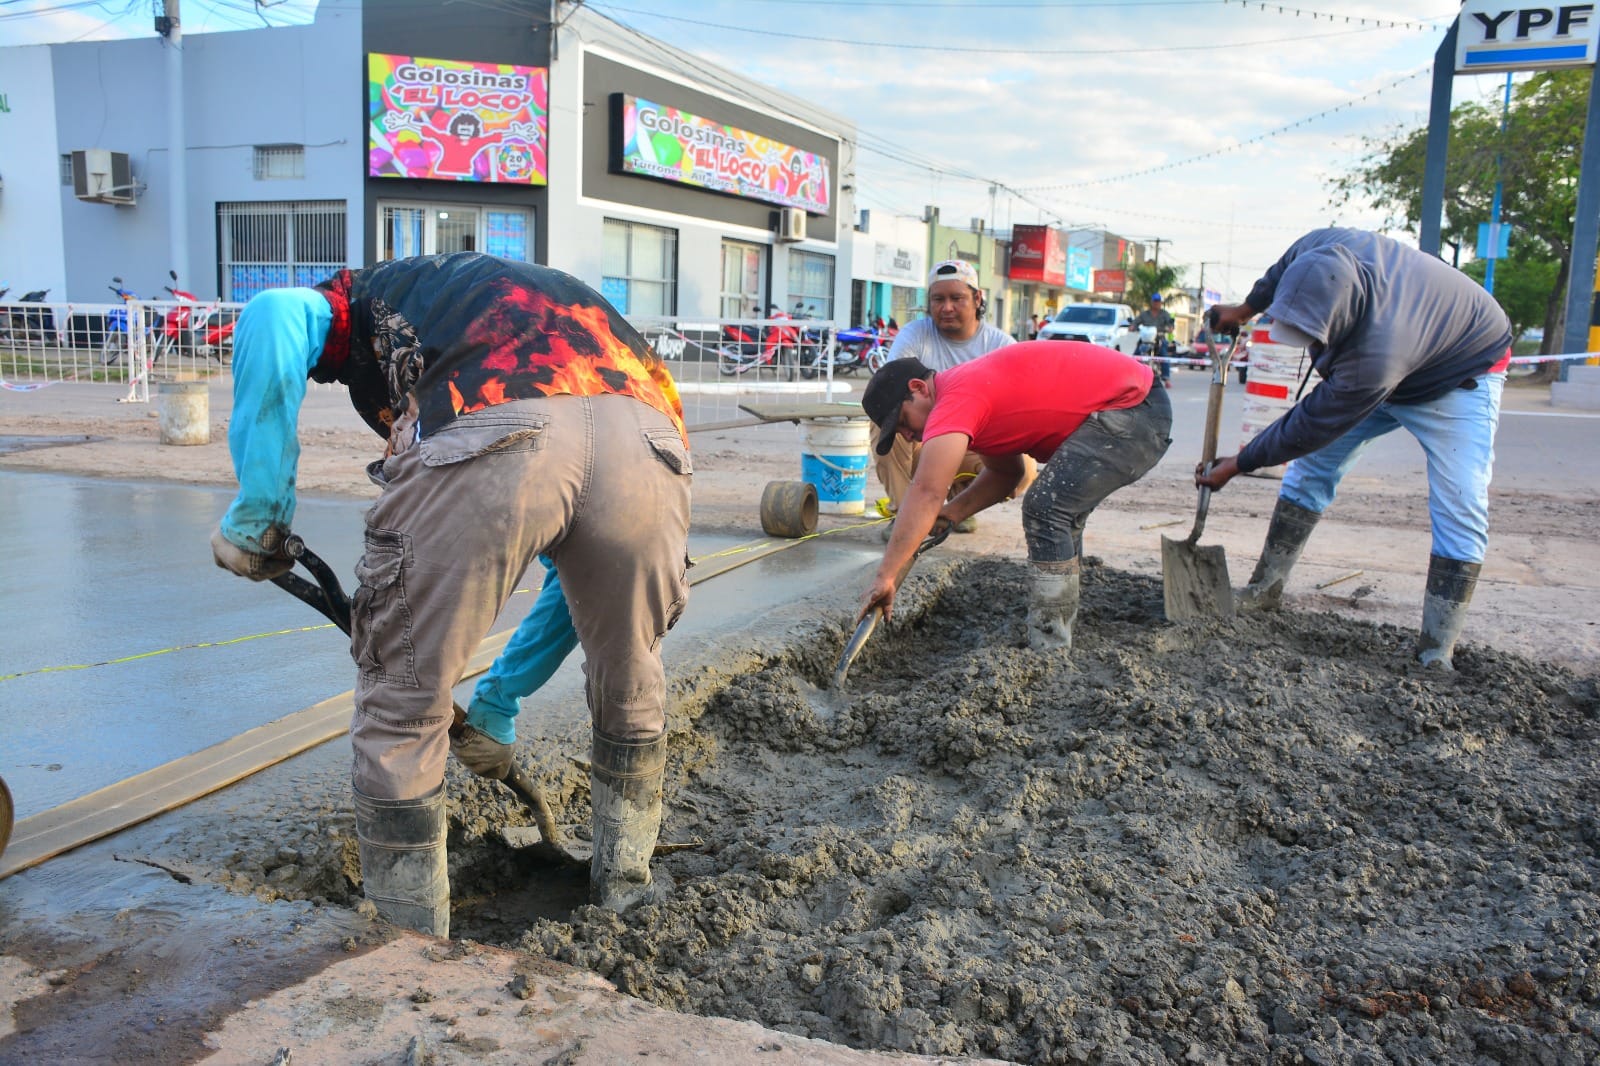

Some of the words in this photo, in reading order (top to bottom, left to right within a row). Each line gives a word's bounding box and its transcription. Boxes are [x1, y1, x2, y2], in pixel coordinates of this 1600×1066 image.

[1472, 5, 1594, 41] YPF
[398, 66, 525, 89] Golosinas
[639, 109, 746, 154] Golosinas
[633, 158, 683, 177] Turrones
[691, 172, 735, 188] Alfajores
